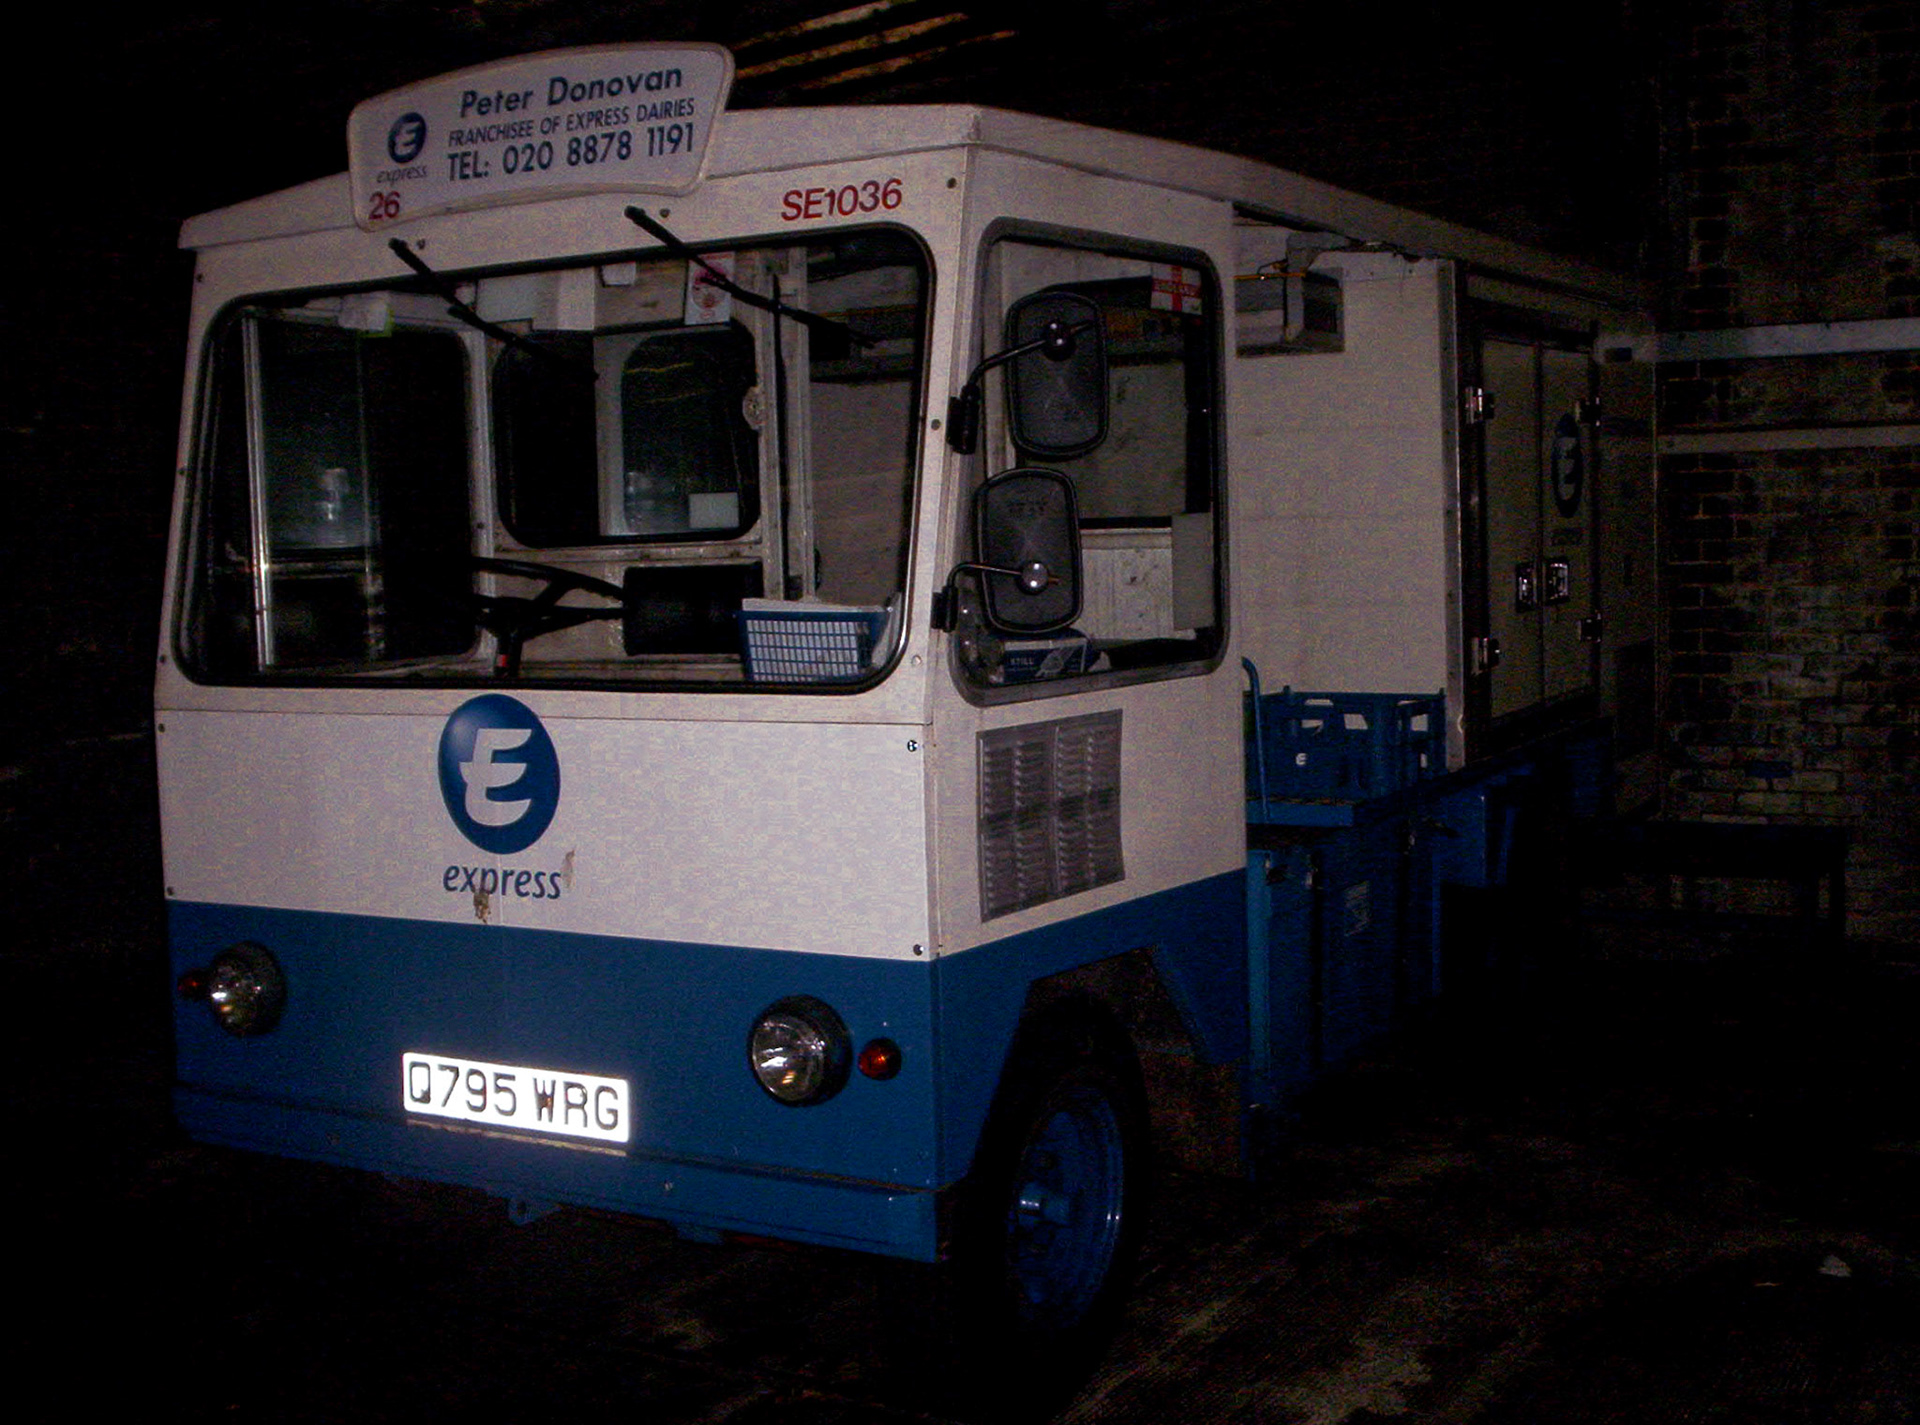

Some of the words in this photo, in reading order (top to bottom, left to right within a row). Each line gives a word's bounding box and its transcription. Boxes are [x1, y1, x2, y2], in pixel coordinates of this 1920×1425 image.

[460, 89, 534, 118] Peter
[547, 68, 682, 106] Donovan
[448, 120, 534, 147] FRANCHISEE
[540, 115, 560, 135] OF
[566, 106, 630, 132] EXPRESS
[636, 97, 695, 122] DAIRIES
[447, 151, 489, 181] TEL:
[502, 140, 554, 174] 020
[566, 130, 632, 166] 8878
[647, 121, 694, 156] 1191
[376, 165, 428, 187] express
[369, 191, 400, 220] 26
[781, 178, 903, 221] SE1036
[443, 864, 561, 899] express
[409, 1061, 517, 1117] Q795
[533, 1077, 619, 1131] WRG
